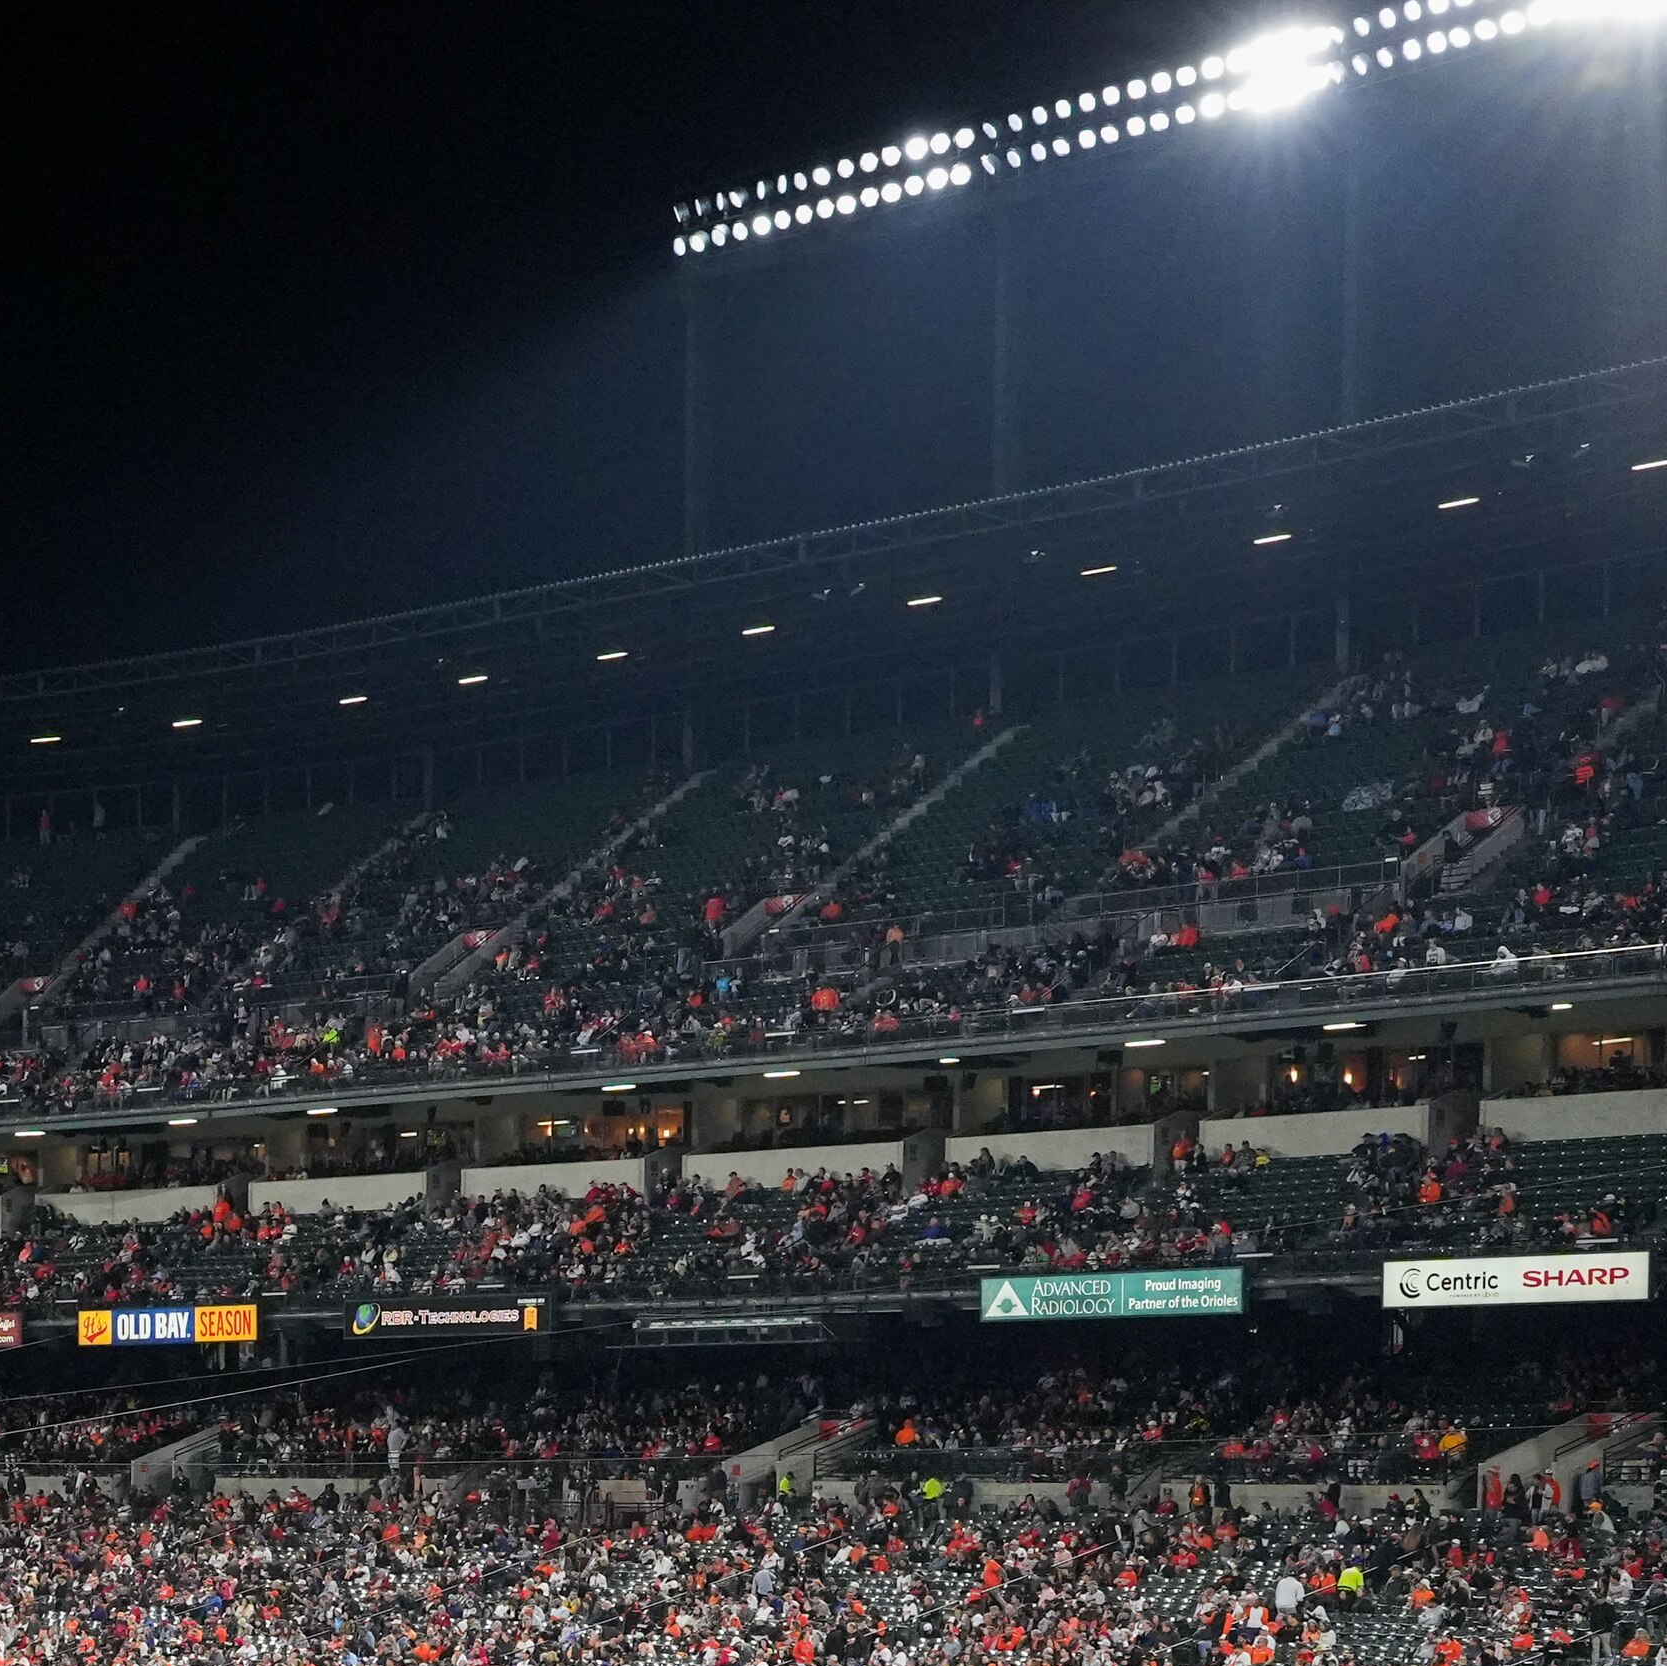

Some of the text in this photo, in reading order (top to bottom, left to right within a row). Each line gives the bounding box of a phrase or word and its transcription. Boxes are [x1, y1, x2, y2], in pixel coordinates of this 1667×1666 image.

[1144, 1277, 1221, 1293] Proud Imaging
[1426, 1271, 1499, 1291] Centric
[1522, 1267, 1630, 1288] SHARP
[1031, 1278, 1111, 1298] ADVANCED
[1031, 1297, 1116, 1316] RADIOLOGY
[1128, 1294, 1239, 1311] Partner of the Orioles
[117, 1313, 153, 1340] OLD
[200, 1309, 252, 1337] SEASON
